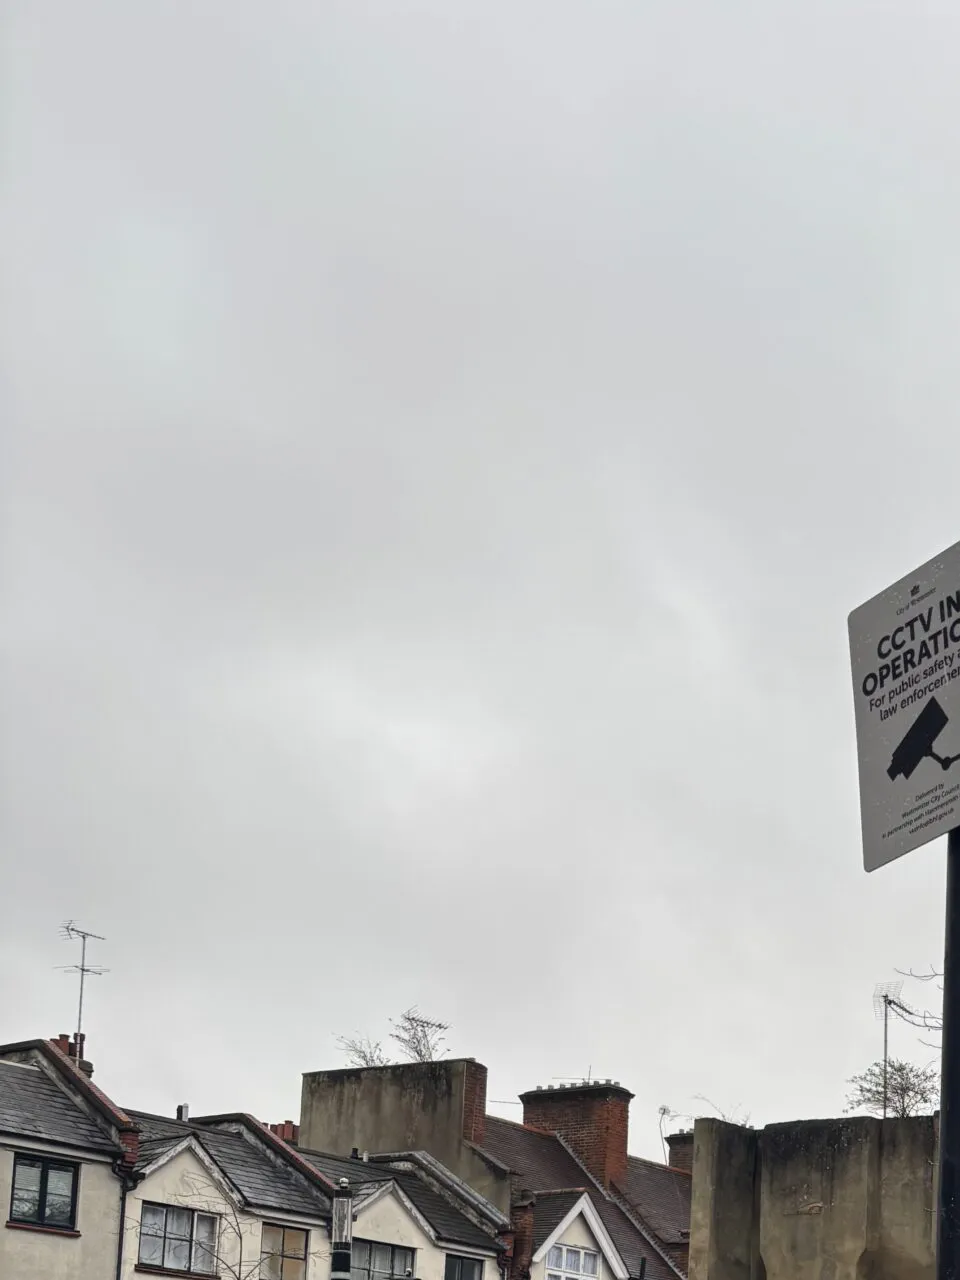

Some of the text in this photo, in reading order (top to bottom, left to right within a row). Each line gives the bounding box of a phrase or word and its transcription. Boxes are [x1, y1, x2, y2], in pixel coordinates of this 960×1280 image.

[877, 606, 934, 660] CCTV
[869, 695, 886, 712] For
[888, 673, 921, 701] public
[922, 653, 954, 681] safety
[879, 705, 898, 722] law
